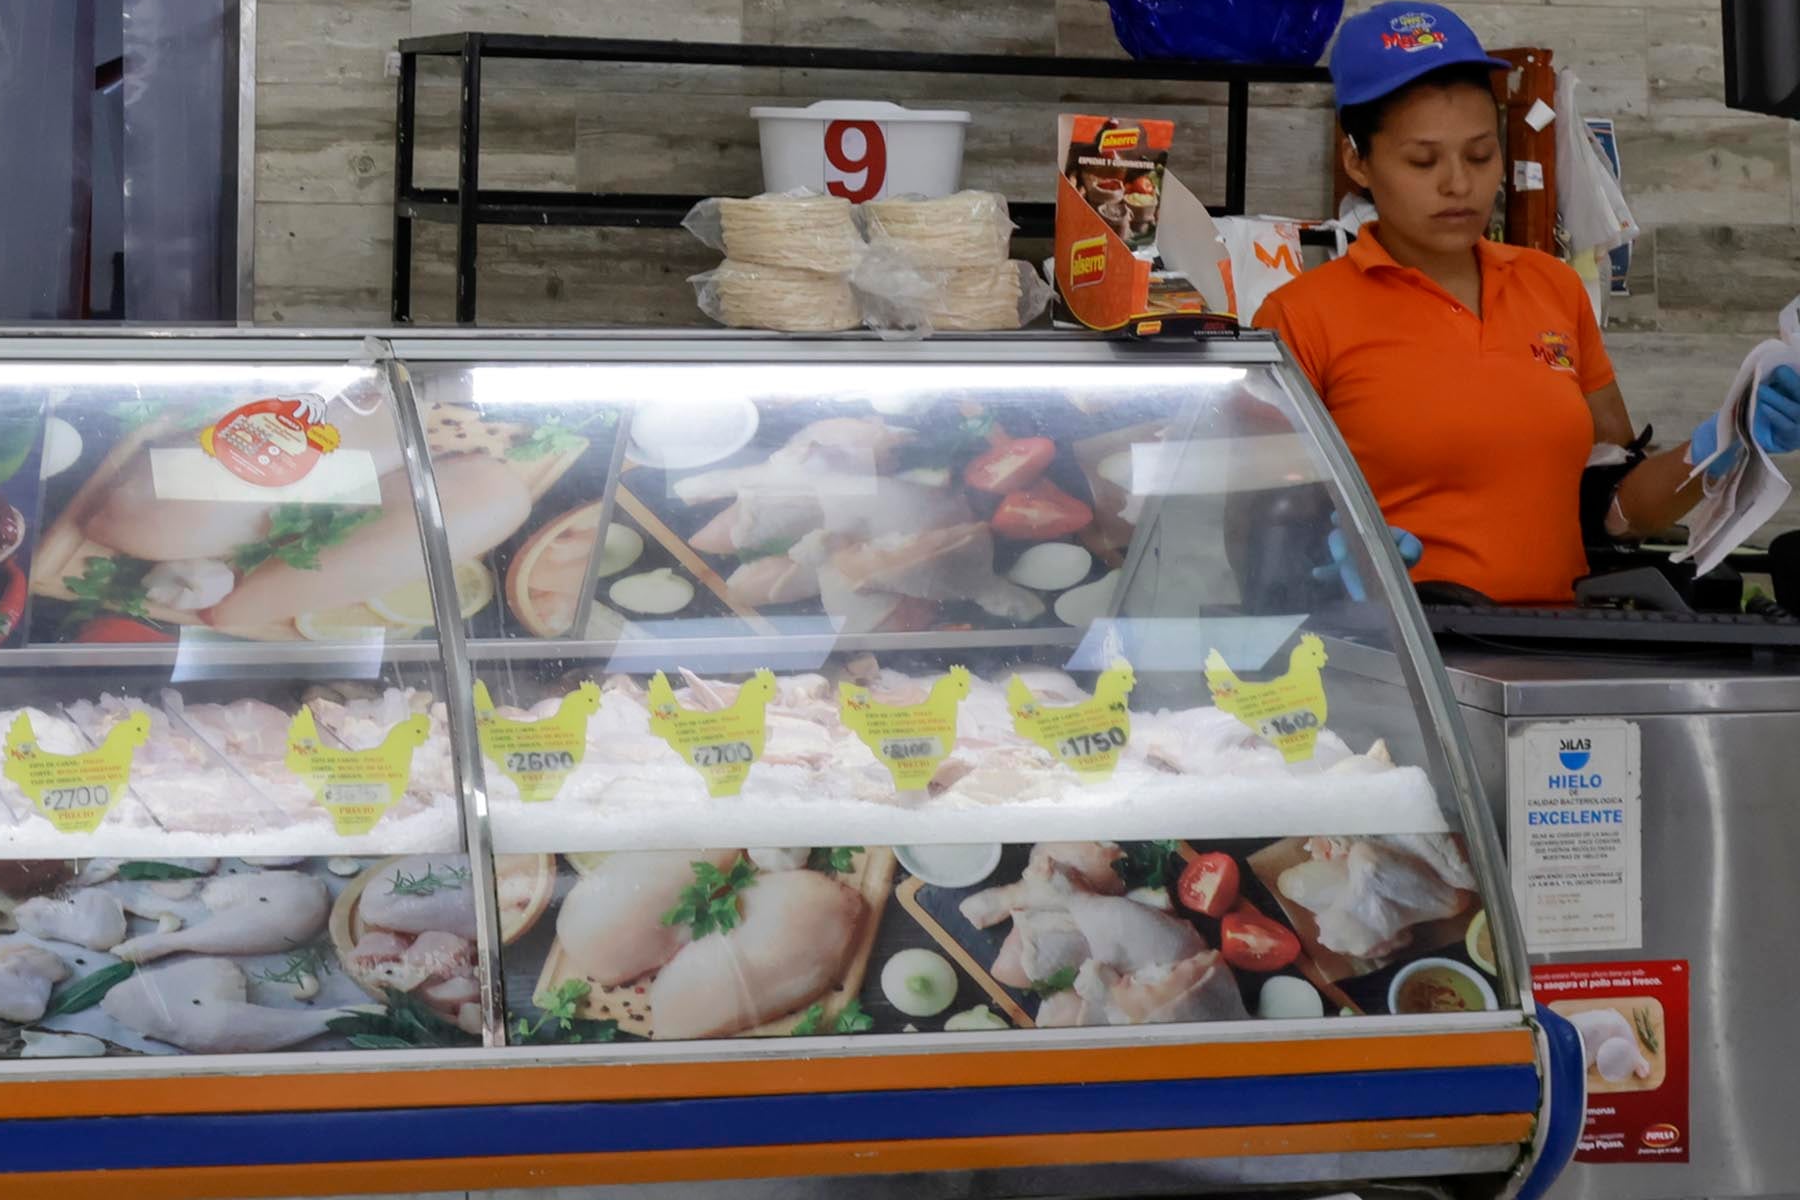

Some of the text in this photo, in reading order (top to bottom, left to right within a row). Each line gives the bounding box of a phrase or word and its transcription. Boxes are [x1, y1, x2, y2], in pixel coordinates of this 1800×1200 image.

[824, 120, 886, 204] 9
[1549, 774, 1602, 789] HIELO
[1528, 798, 1558, 806] CALIDAD
[1528, 809, 1623, 825] EXCELENTE
